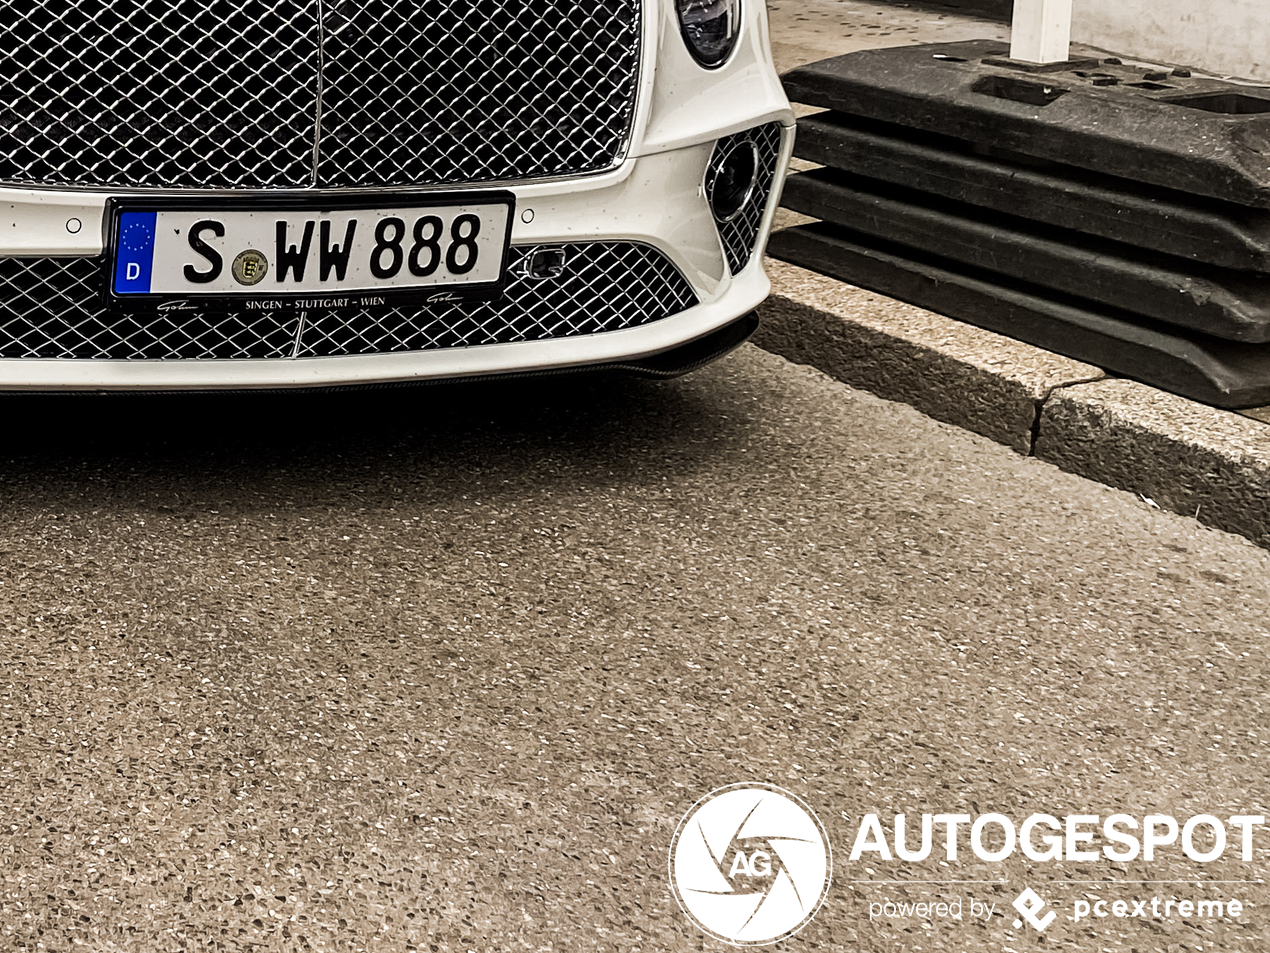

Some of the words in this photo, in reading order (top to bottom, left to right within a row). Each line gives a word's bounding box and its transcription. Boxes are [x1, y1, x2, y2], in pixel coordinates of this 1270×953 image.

[183, 220, 226, 284] S
[275, 219, 358, 283] WW
[369, 213, 482, 280] 888
[126, 262, 140, 281] D
[245, 299, 283, 311] SINGEN
[295, 297, 349, 309] STUTTGART
[360, 296, 386, 307] WIEN
